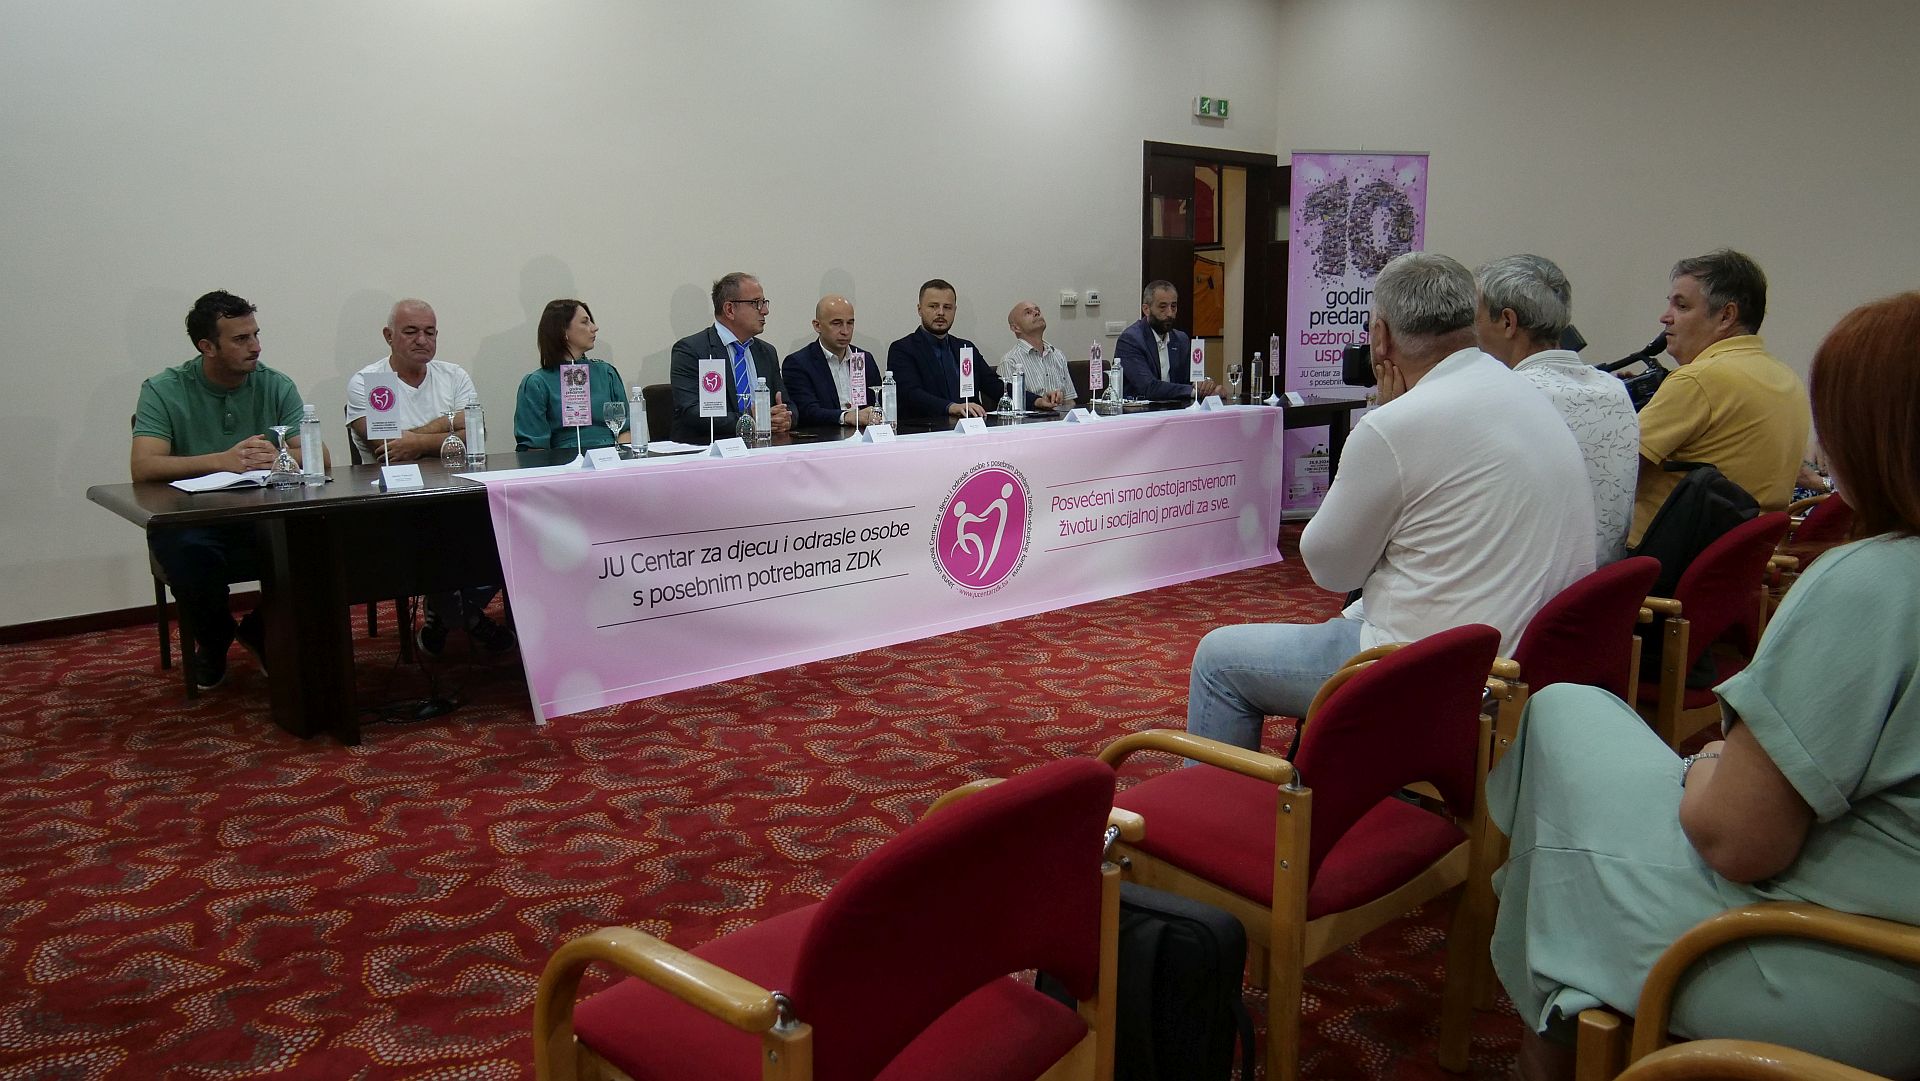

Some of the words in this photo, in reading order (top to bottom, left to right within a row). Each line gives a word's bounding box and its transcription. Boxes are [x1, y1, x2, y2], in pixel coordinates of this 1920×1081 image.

[1302, 177, 1416, 278] 10
[1326, 287, 1373, 309] godin
[1310, 307, 1370, 329] predan
[1299, 370, 1309, 378] JU
[929, 523, 938, 546] Centar
[951, 472, 969, 491] odrasle
[1051, 488, 1115, 512] Posvećeni
[1118, 487, 1143, 503] smo
[1145, 473, 1236, 499] dostojanstvenom
[1101, 514, 1104, 530] i
[1106, 506, 1158, 529] socijalnoj
[1162, 500, 1194, 522] pravdi
[1197, 500, 1208, 514] za
[1210, 496, 1230, 511] sve.
[598, 555, 625, 580] JU
[631, 549, 695, 574] Centar
[701, 546, 722, 564] za
[727, 539, 778, 563] djecu
[783, 535, 788, 553] i
[793, 527, 856, 551] odrasle
[860, 521, 910, 542] osobe
[632, 590, 644, 607] s
[650, 573, 742, 608] posebnim
[747, 558, 841, 592] potrebama
[845, 549, 882, 572] ZDK
